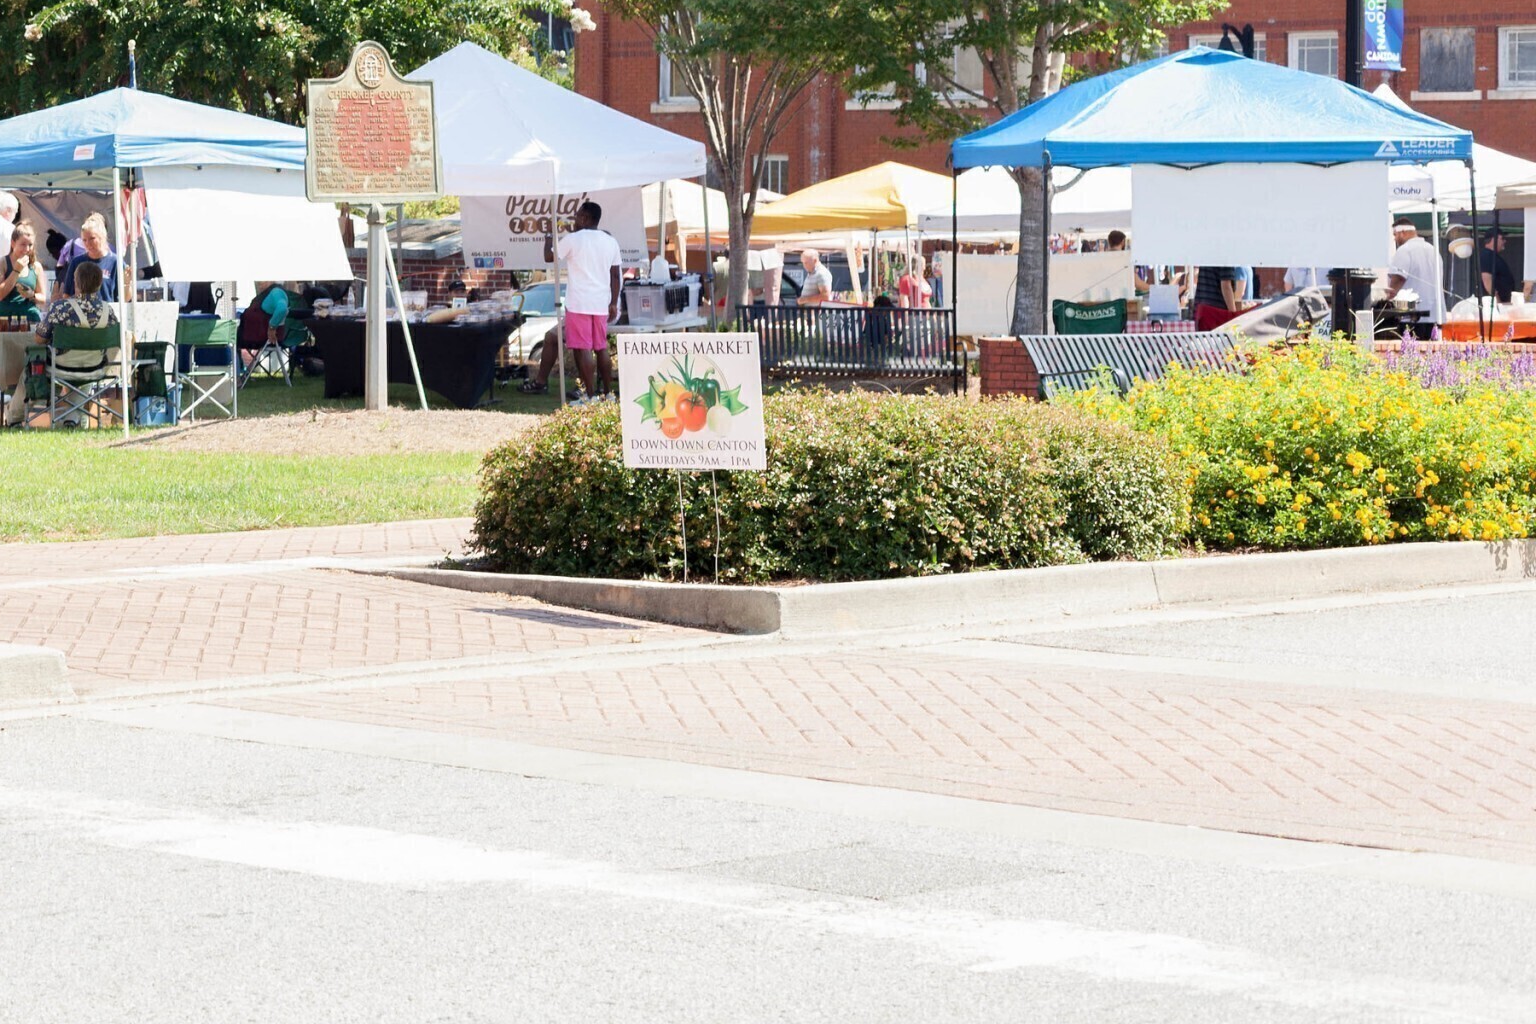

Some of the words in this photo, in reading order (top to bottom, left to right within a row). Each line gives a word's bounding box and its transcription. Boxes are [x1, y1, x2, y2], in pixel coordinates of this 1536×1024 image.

[327, 90, 374, 101] CHEROKEE
[377, 90, 415, 101] COUNTY
[1402, 138, 1456, 149] LEADER
[1393, 186, 1422, 195] Ohuhu
[505, 191, 590, 216] Paula'
[624, 340, 689, 355] FARMERS
[692, 340, 753, 355] MARKET
[630, 439, 704, 451] DOWNTOWN
[707, 439, 758, 451] CANTON
[698, 454, 720, 466] 9AM
[730, 456, 751, 466] 1PM
